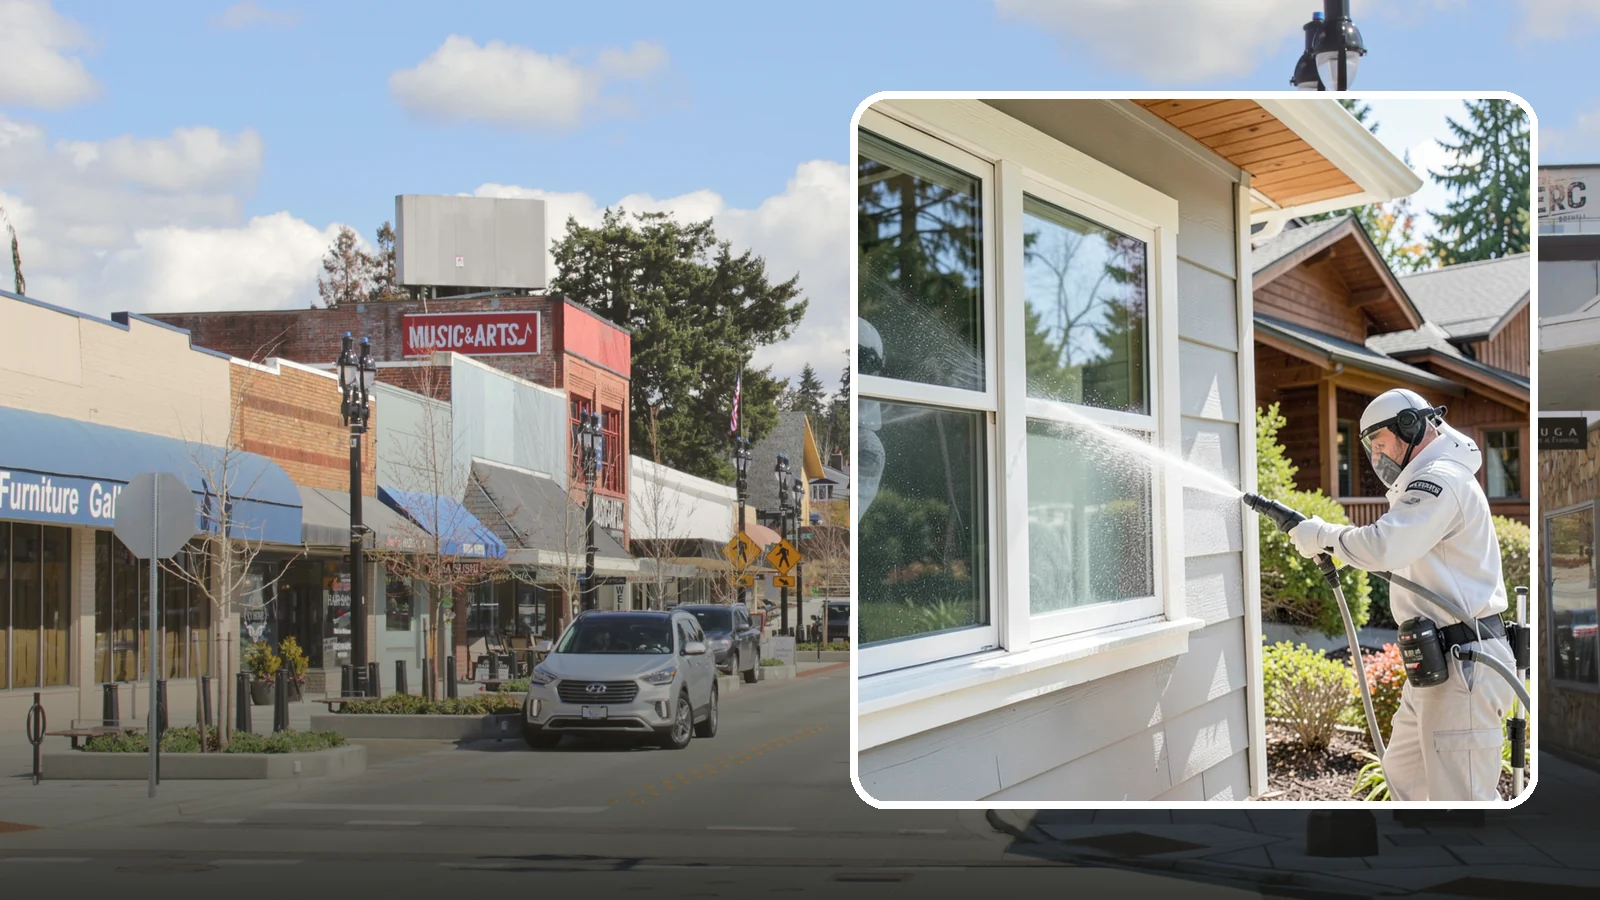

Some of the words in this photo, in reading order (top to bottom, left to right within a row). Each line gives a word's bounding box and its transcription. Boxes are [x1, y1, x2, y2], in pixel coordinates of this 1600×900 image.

[409, 323, 519, 348] MUSIC&ARTS
[0, 471, 79, 515] Furniture
[90, 482, 121, 519] Gal
[453, 563, 479, 574] SUSHI
